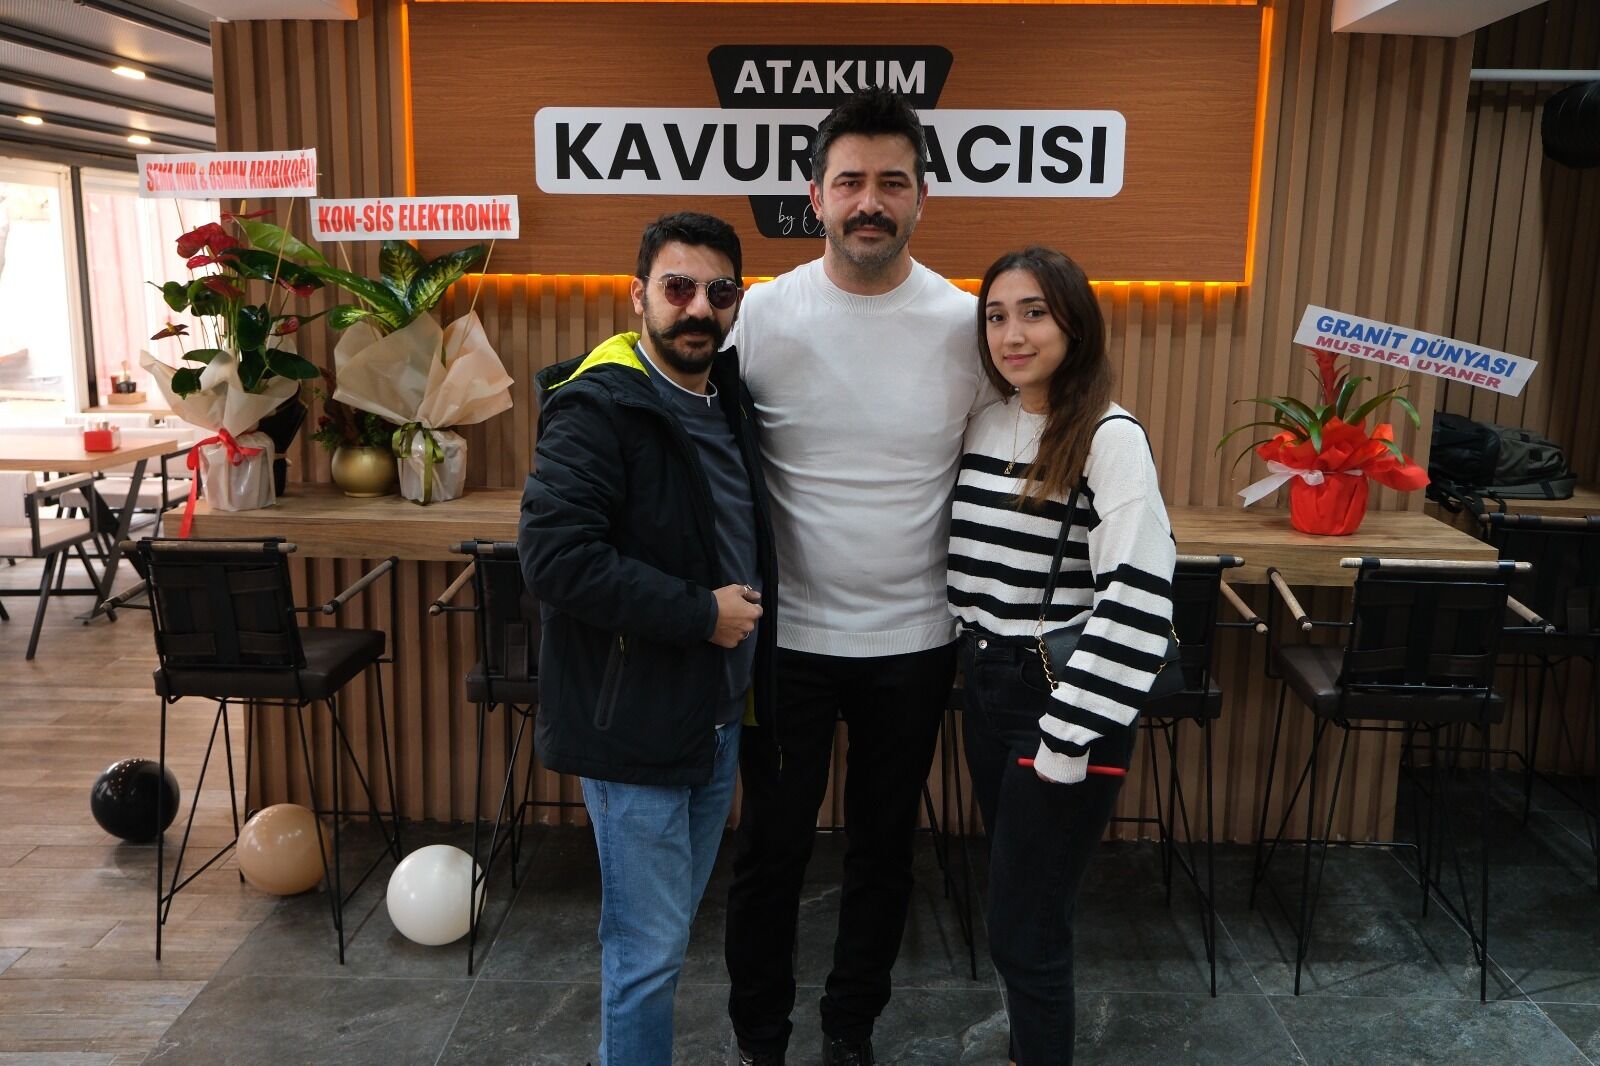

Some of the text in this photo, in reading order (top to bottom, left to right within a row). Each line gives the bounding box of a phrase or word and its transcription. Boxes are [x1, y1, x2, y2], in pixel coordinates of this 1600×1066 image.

[733, 59, 926, 95] ATAKUM
[555, 122, 1108, 185] KAVURACISI
[176, 162, 198, 191] NUR
[209, 160, 247, 190] OSMAN
[318, 198, 512, 233] KON-SİS ELEKTRONİK
[777, 200, 795, 236] by
[1315, 335, 1502, 389] MUSTAFA UYANER
[1316, 315, 1518, 378] GRANİT DÜNYASI
